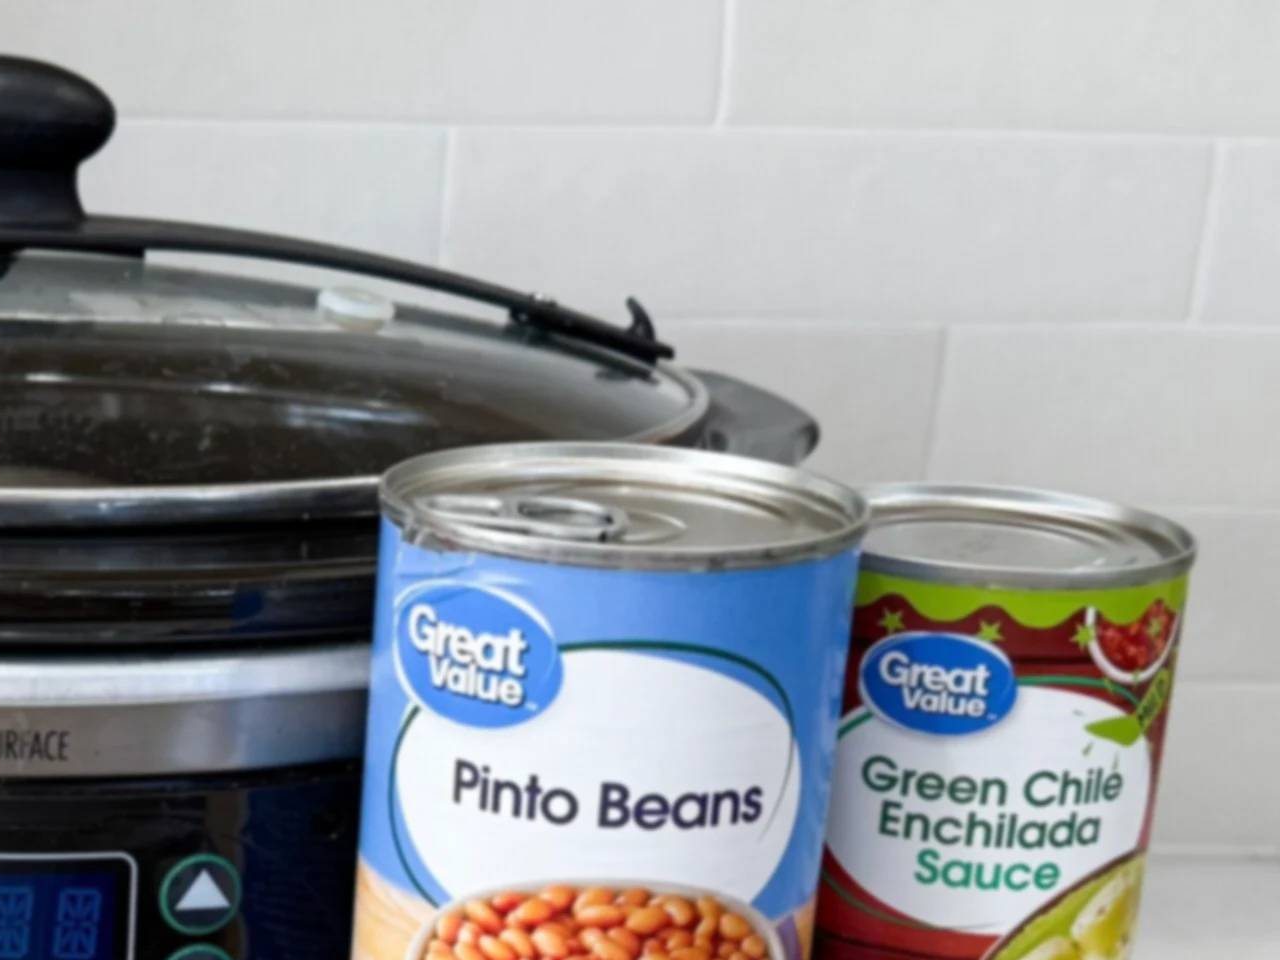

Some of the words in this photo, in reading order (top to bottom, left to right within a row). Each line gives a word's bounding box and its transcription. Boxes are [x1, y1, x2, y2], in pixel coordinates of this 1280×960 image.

[408, 603, 527, 675] Great
[428, 656, 523, 707] Value
[878, 650, 991, 697] Great
[902, 687, 987, 718] Value
[452, 757, 579, 825] Pinto
[596, 779, 764, 830] Beans
[860, 755, 1008, 806] Green
[1022, 767, 1124, 808] Chile
[877, 799, 1101, 850] Enchilada
[913, 848, 1061, 891] Sauce
